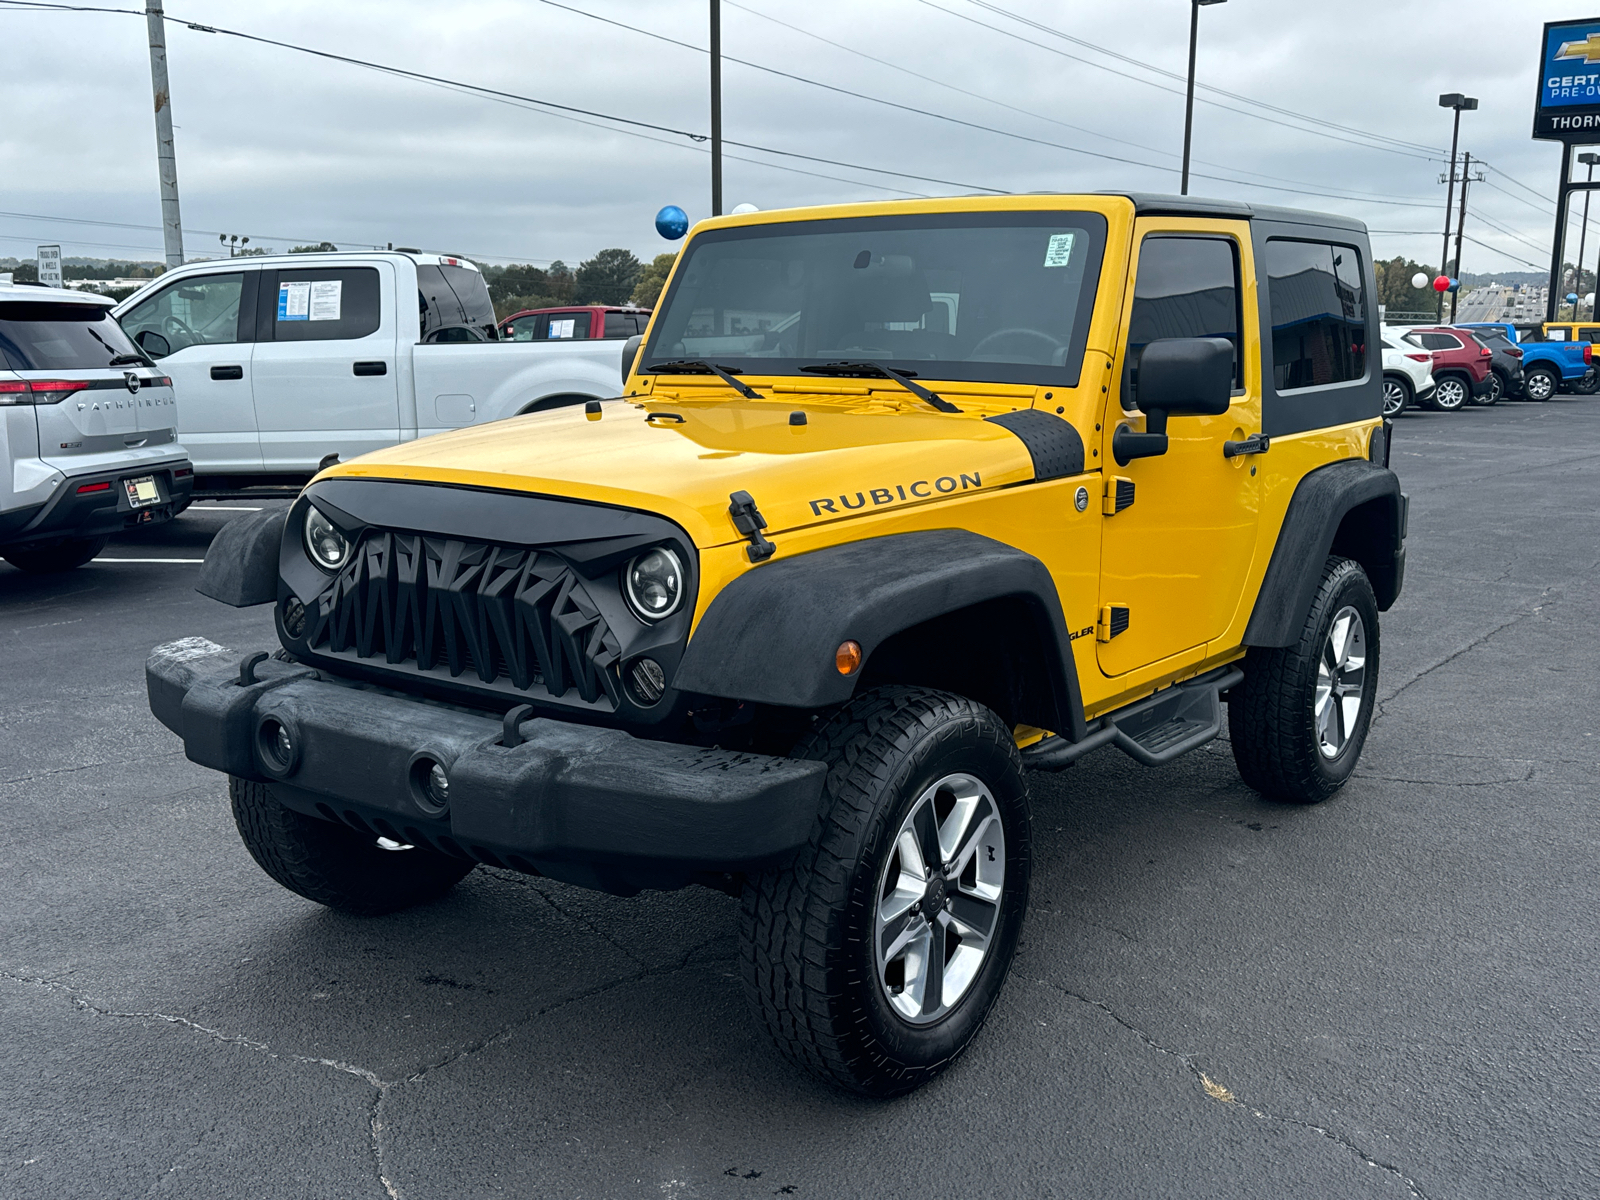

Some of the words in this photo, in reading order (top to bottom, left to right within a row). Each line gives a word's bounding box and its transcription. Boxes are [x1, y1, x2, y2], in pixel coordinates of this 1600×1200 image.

[1547, 74, 1600, 88] CERT
[77, 397, 174, 412] PATHFINDER
[808, 471, 982, 516] RUBICON
